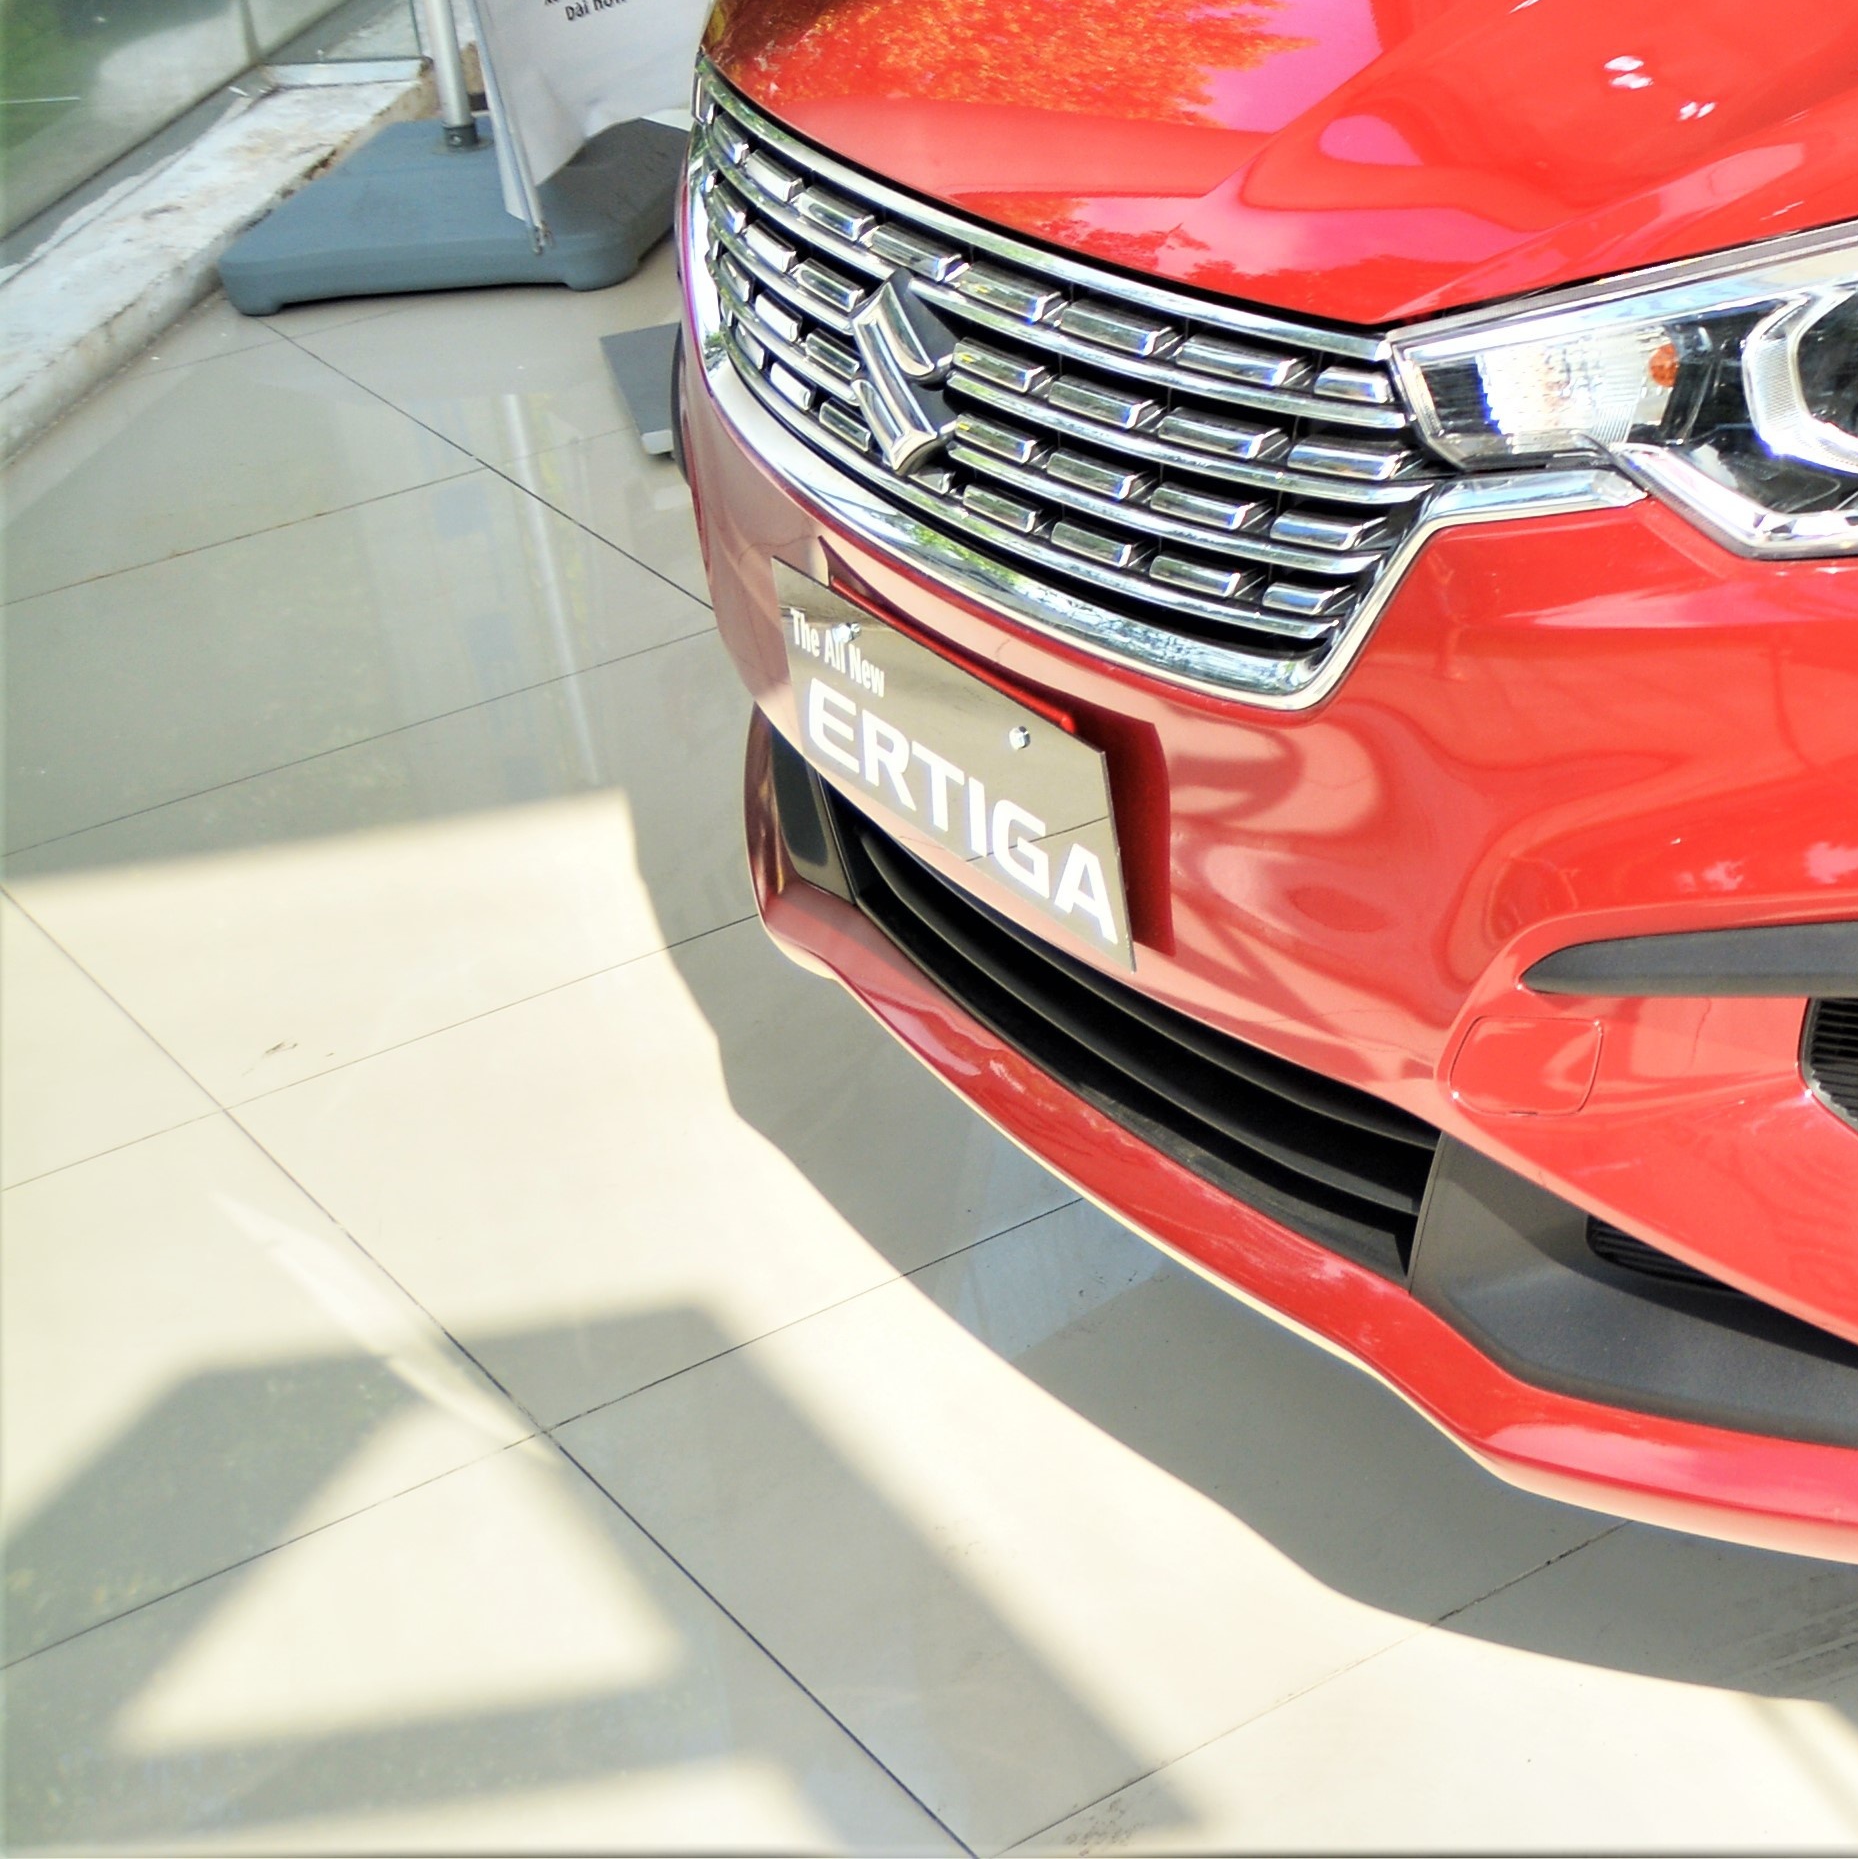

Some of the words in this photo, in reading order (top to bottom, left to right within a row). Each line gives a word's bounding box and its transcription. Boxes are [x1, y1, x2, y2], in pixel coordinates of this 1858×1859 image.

[565, 0, 591, 22] Dài
[790, 608, 820, 657] The
[824, 628, 847, 676] All
[847, 646, 885, 698] New
[808, 677, 1119, 946] ERTIGA
